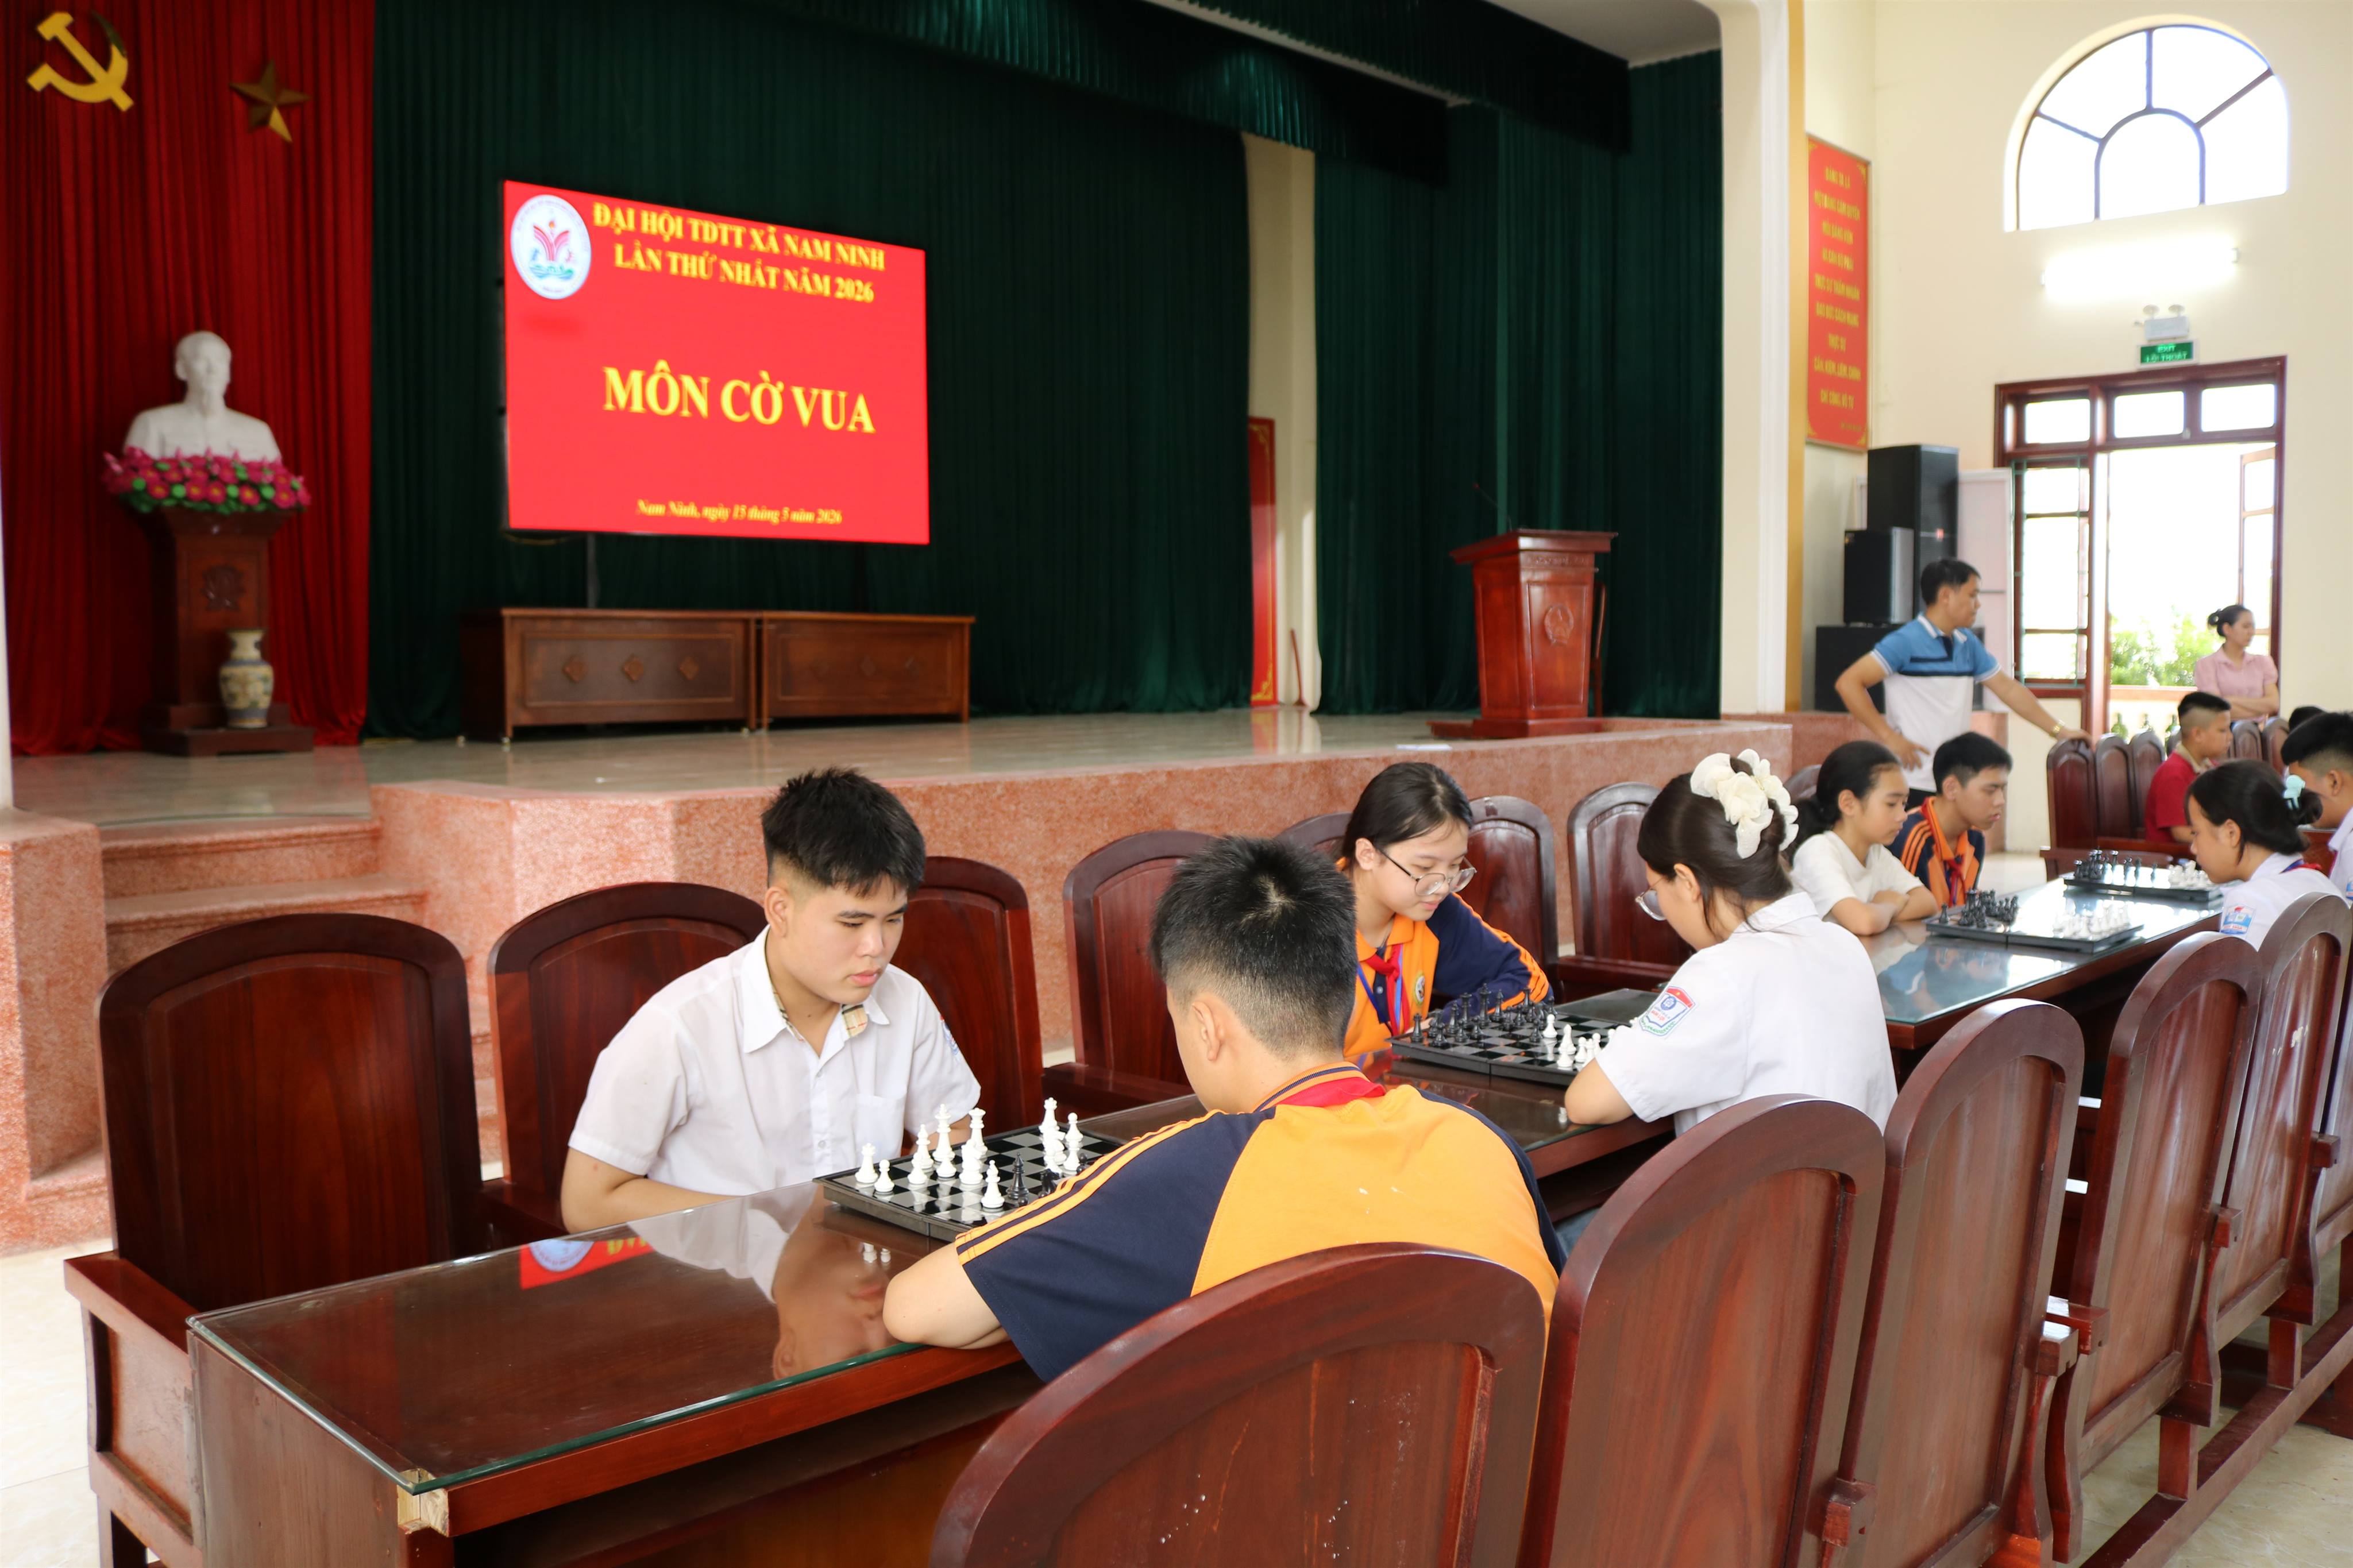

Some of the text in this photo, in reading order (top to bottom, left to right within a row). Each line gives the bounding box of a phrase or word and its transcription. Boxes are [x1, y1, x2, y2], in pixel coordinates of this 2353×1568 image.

[593, 202, 635, 235] ĐẠI
[640, 210, 684, 242] HỘI
[686, 217, 747, 249] TDTT
[783, 233, 832, 263] NAM
[835, 241, 885, 272] NINH
[665, 250, 718, 280] THỨ
[782, 267, 831, 298] NĂM
[835, 276, 875, 304] 2026
[2157, 343, 2176, 353] EXIT
[602, 359, 877, 434] MÔN CỜ VUA
[637, 499, 666, 516] Nam
[732, 504, 746, 520] 15
[816, 509, 843, 525] 2026
